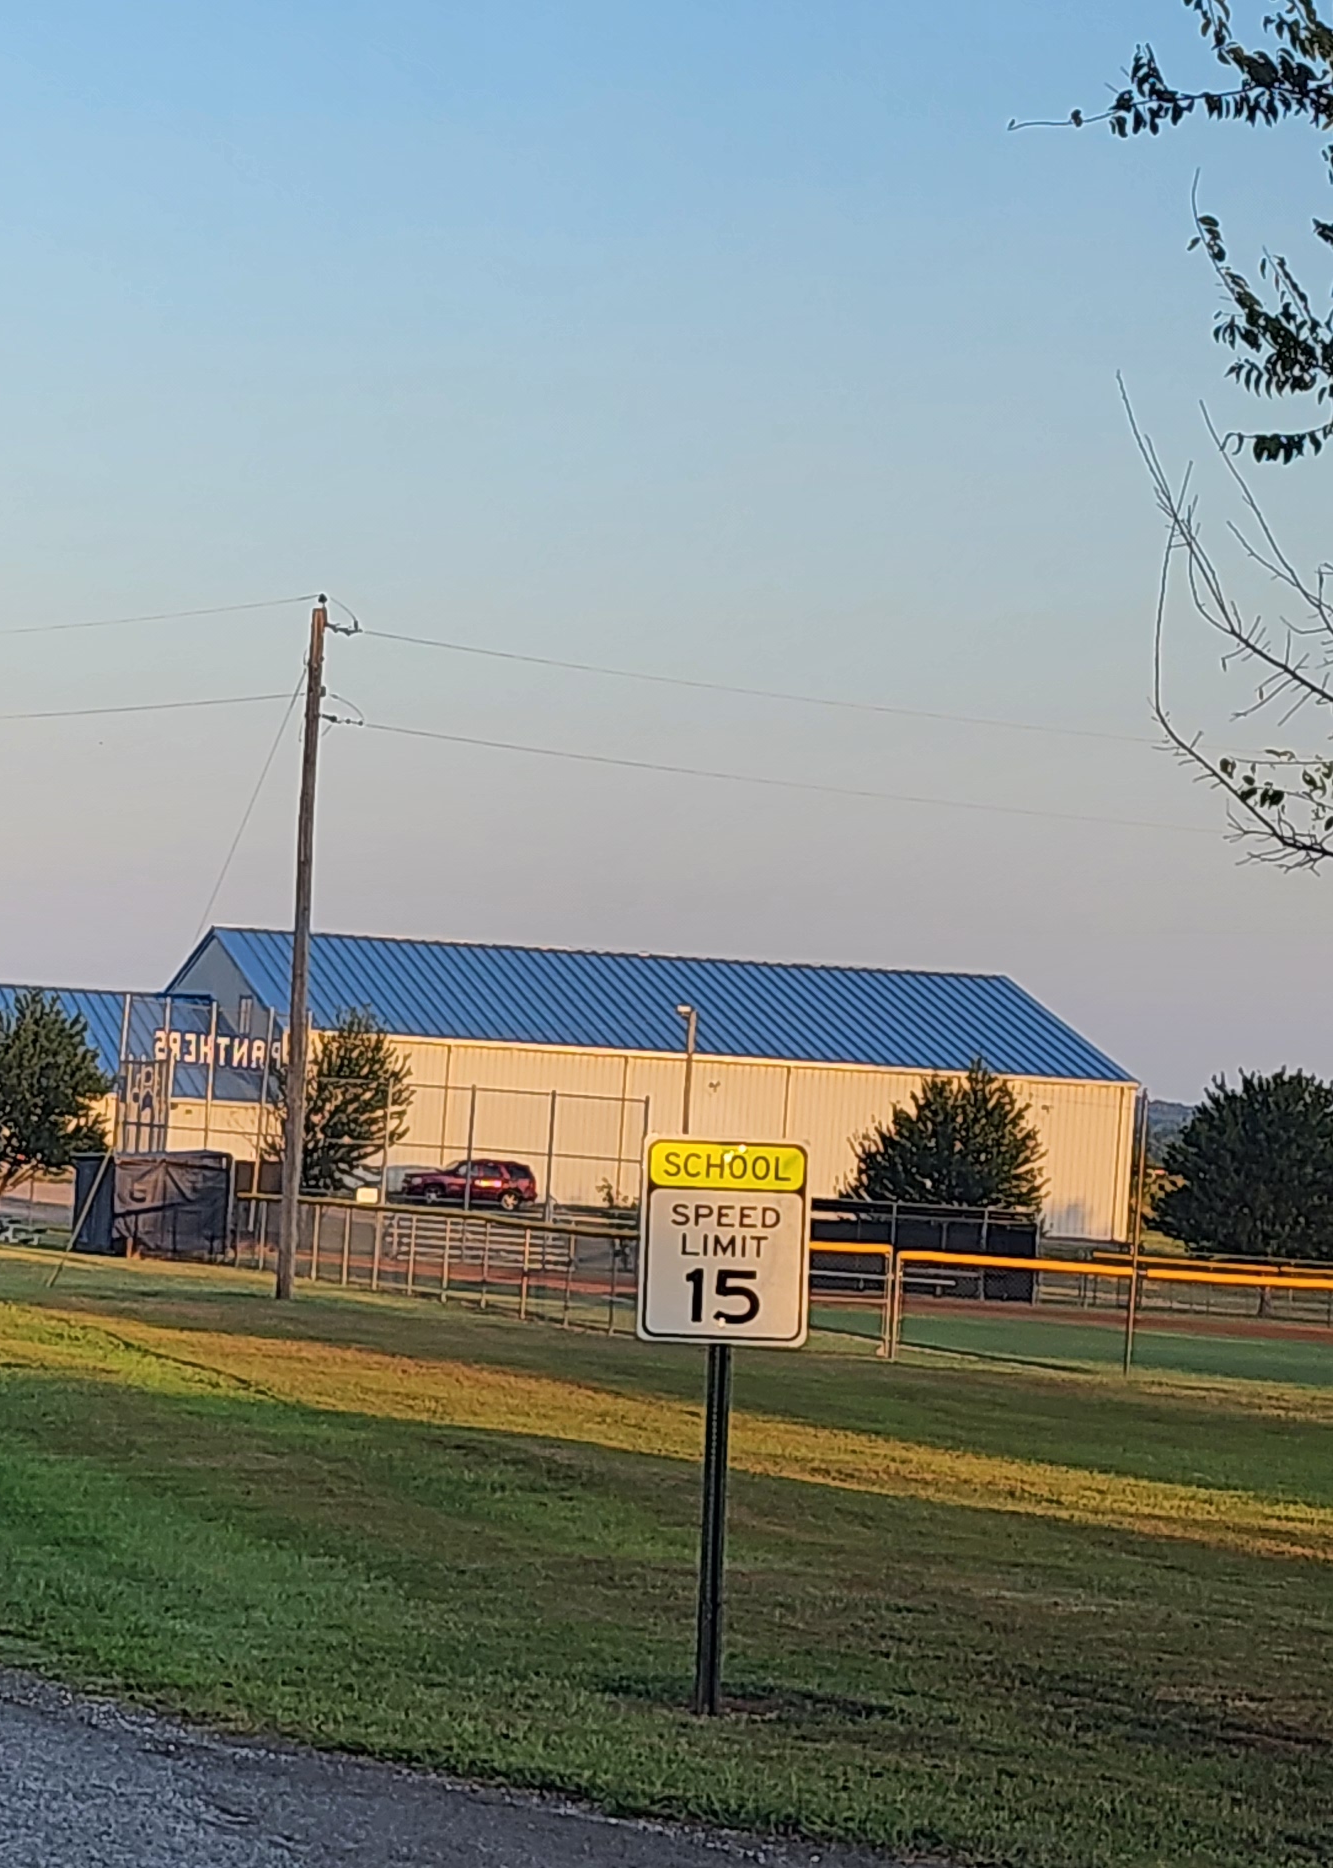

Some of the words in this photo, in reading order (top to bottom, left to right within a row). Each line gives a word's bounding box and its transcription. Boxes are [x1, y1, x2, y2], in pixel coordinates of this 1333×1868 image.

[662, 1151, 792, 1182] SCHOOL
[670, 1203, 782, 1229] SPEED
[680, 1232, 769, 1259] LIMIT
[685, 1267, 761, 1325] 15
